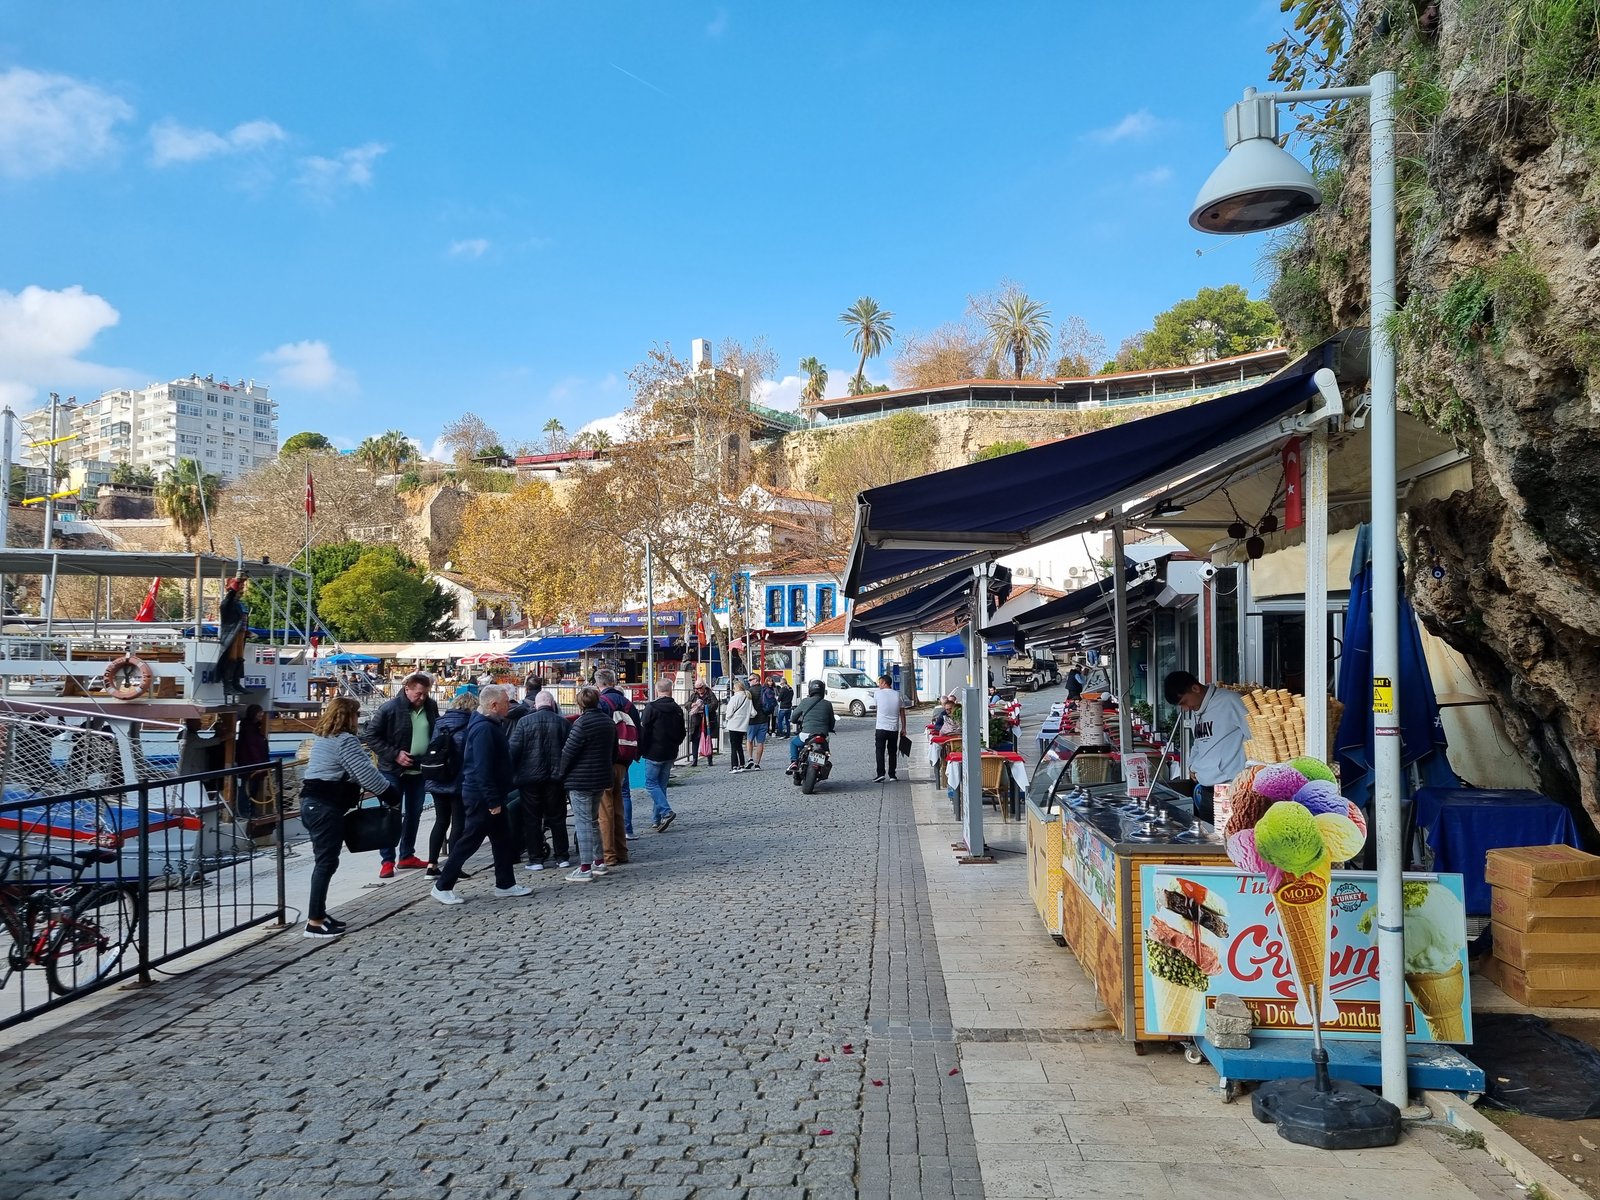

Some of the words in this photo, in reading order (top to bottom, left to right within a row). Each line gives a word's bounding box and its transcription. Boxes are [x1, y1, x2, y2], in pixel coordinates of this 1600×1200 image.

[281, 682, 297, 695] 174
[1283, 887, 1322, 900] MODA
[1335, 893, 1362, 902] TURKEY
